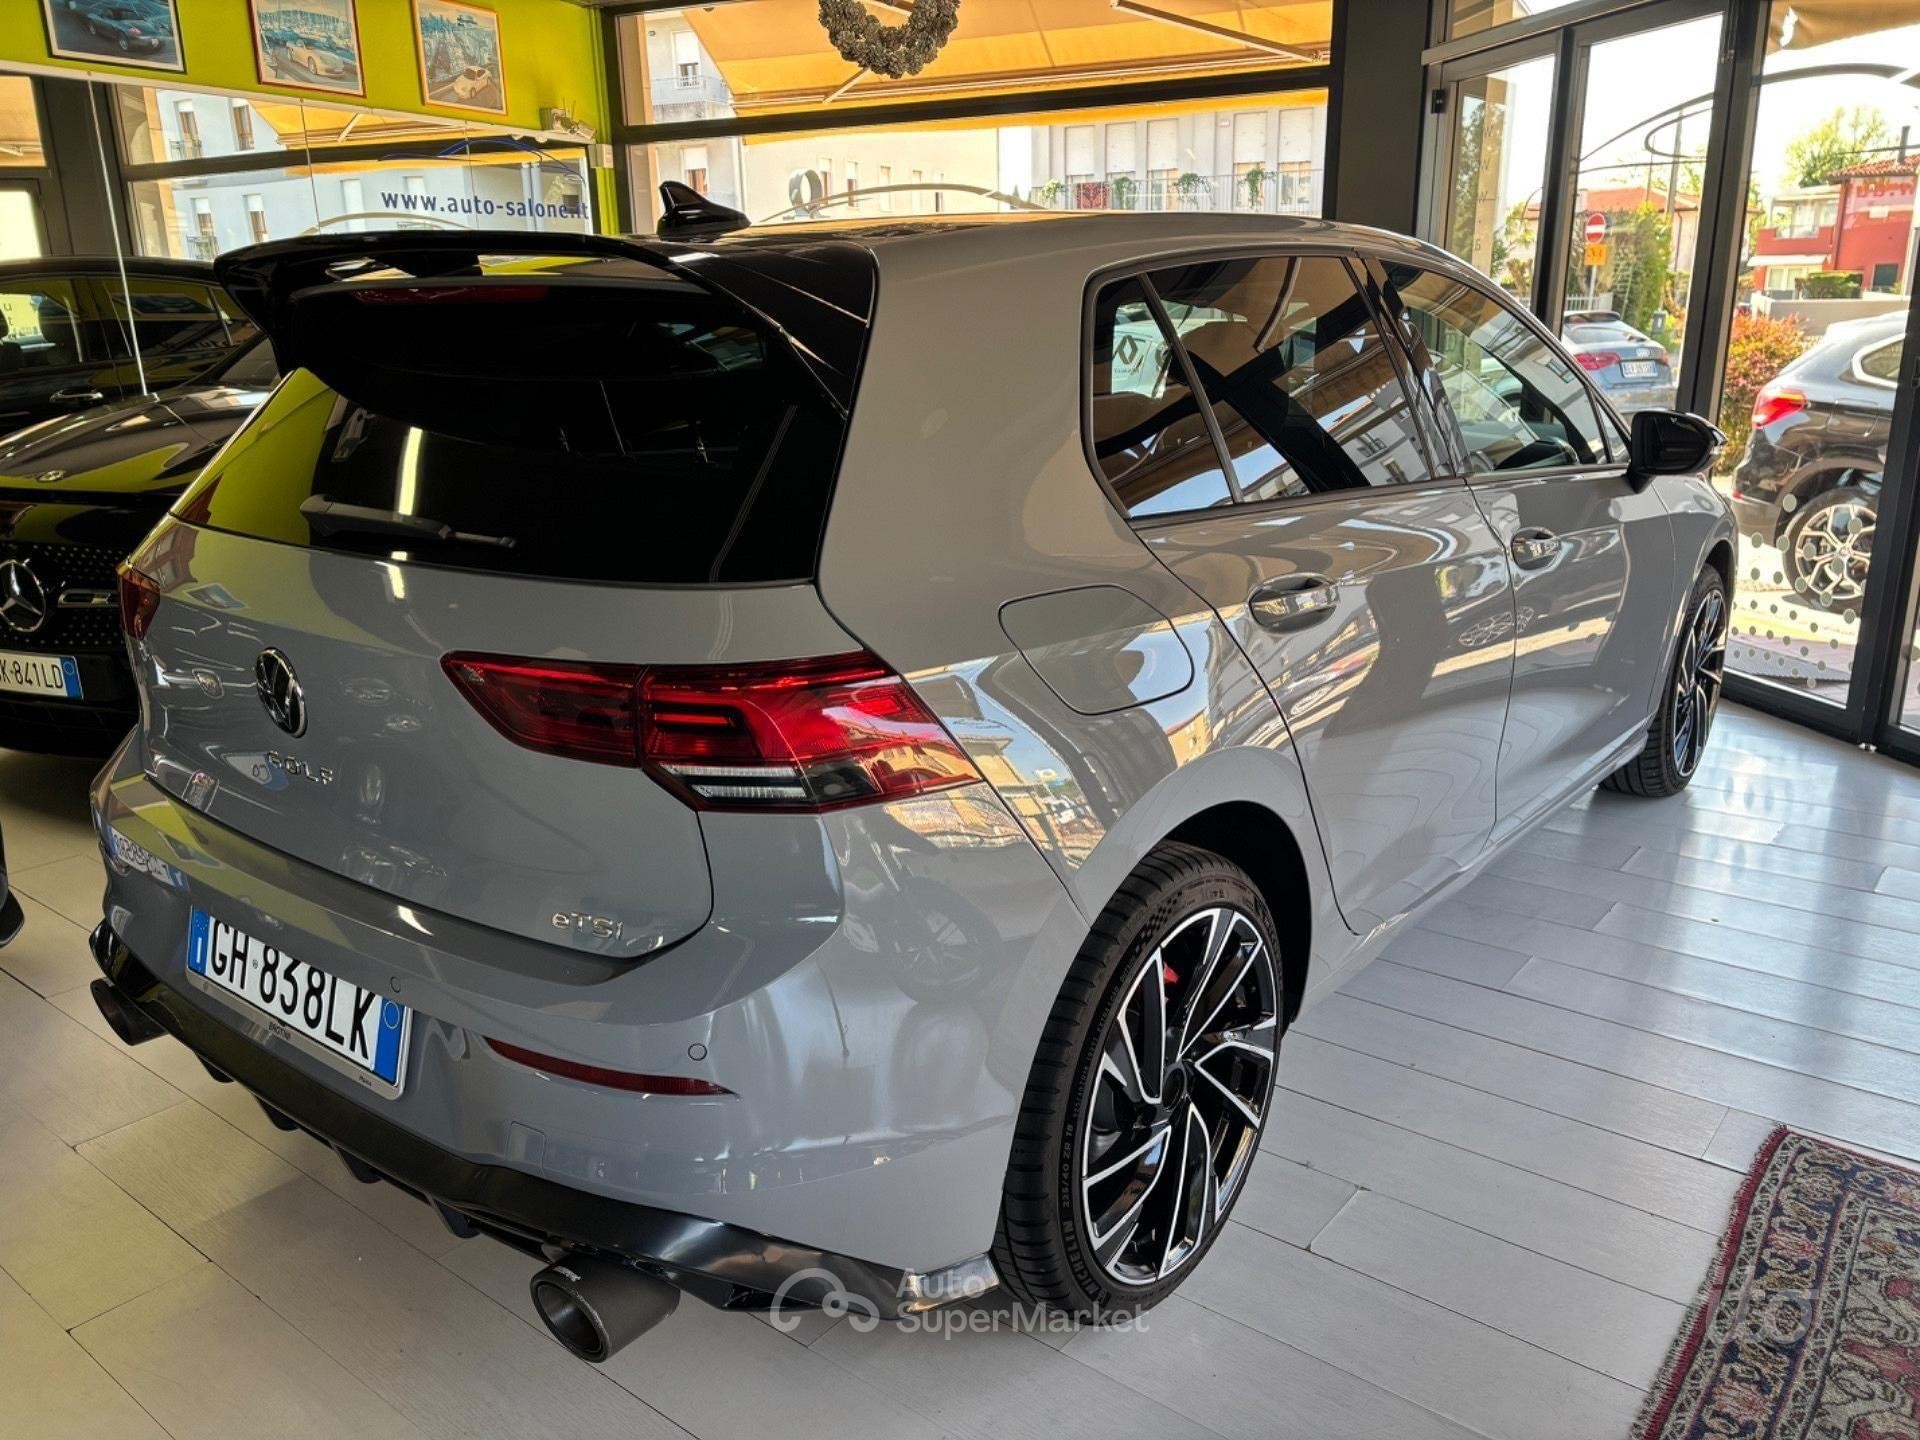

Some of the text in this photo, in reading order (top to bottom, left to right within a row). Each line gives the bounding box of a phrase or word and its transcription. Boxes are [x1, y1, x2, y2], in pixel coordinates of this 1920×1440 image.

[381, 192, 589, 220] www.auto-salone.it
[0, 659, 64, 689] K 841LD
[260, 945, 376, 1060] 838LK
[1062, 1220, 1101, 1297] MICHELIN
